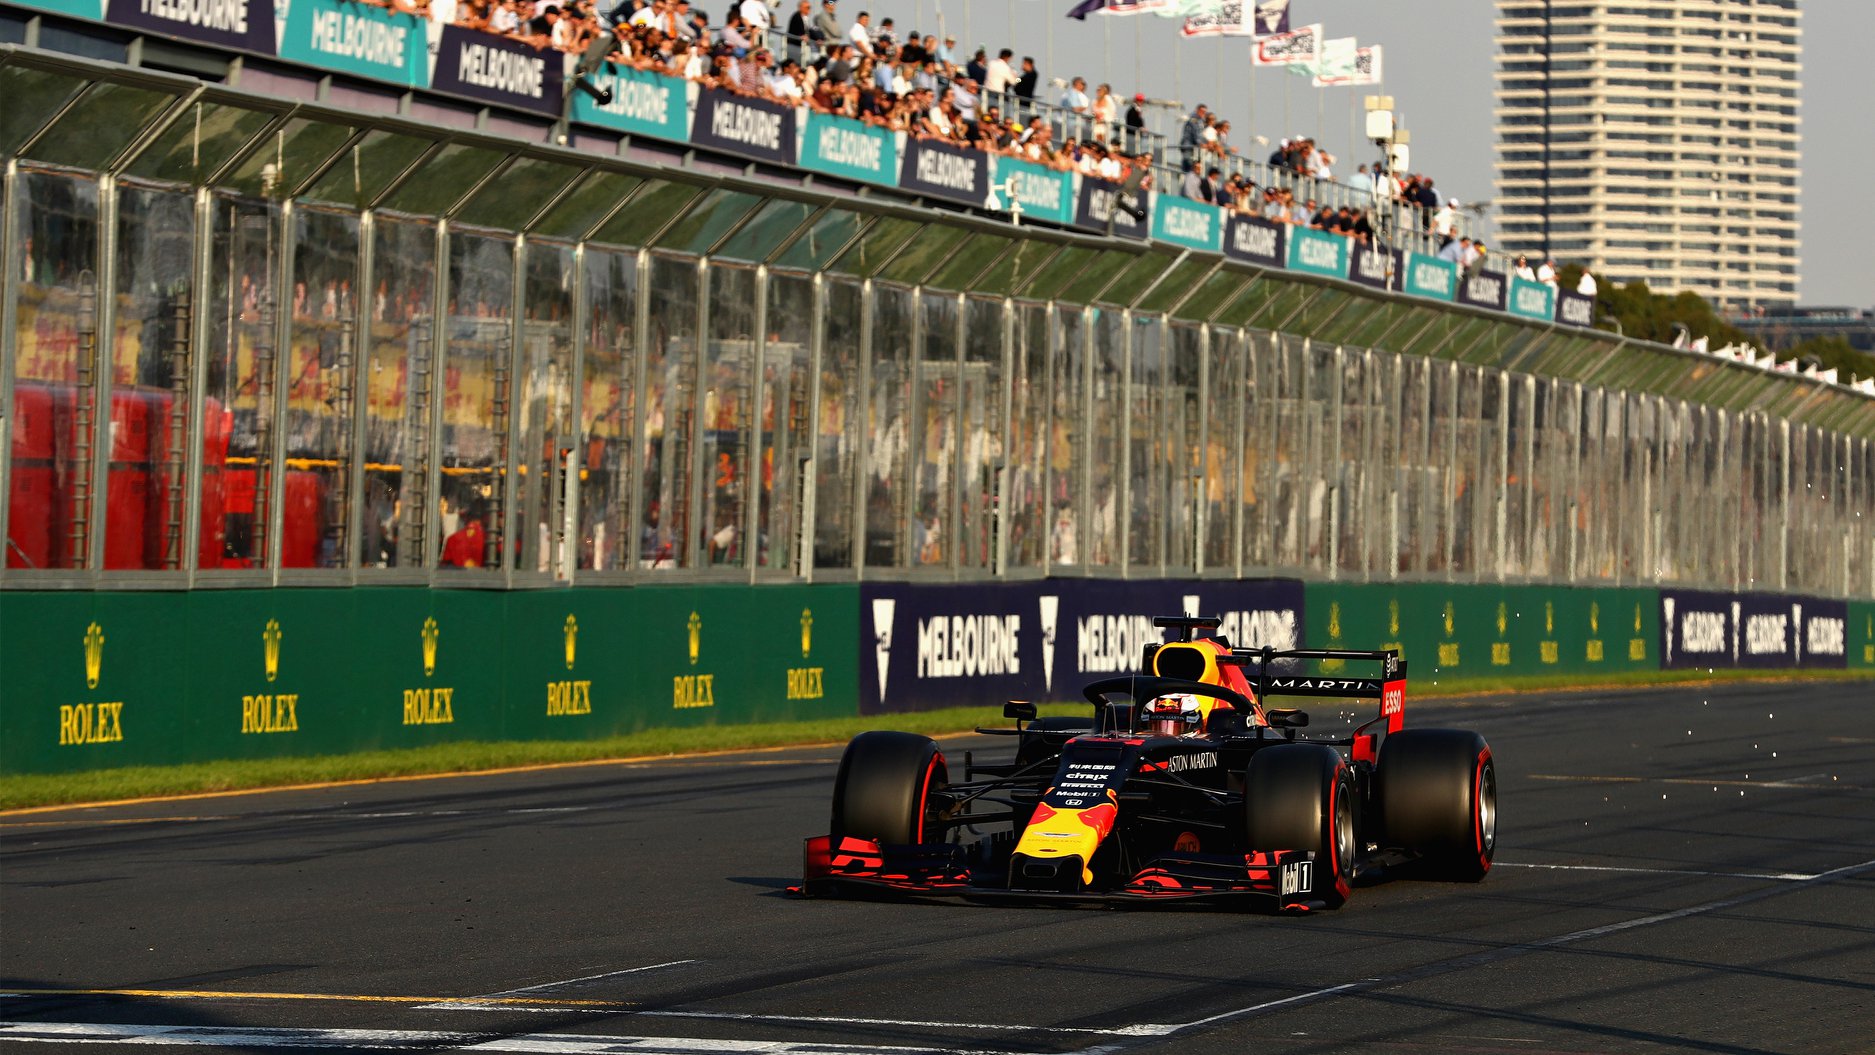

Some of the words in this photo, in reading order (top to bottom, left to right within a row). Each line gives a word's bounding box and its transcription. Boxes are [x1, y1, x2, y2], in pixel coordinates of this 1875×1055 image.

[310, 7, 407, 68] MELBOURNE
[458, 41, 545, 98] MELBOURNE
[711, 100, 782, 150] MELBOURNE
[818, 125, 882, 171] MELBOURNE
[917, 614, 1021, 679] MELBOURNE
[1077, 614, 1167, 673] MELBOUR
[547, 680, 592, 716] ROLEX
[673, 674, 714, 708] ROLEX
[787, 667, 824, 699] ROLEX
[59, 702, 124, 745] ROLEX
[241, 694, 299, 733] ROLEX
[403, 688, 455, 725] ROLEX
[1168, 755, 1188, 772] ASTON
[1190, 752, 1218, 769] MARTIN
[1281, 862, 1300, 895] Mobil
